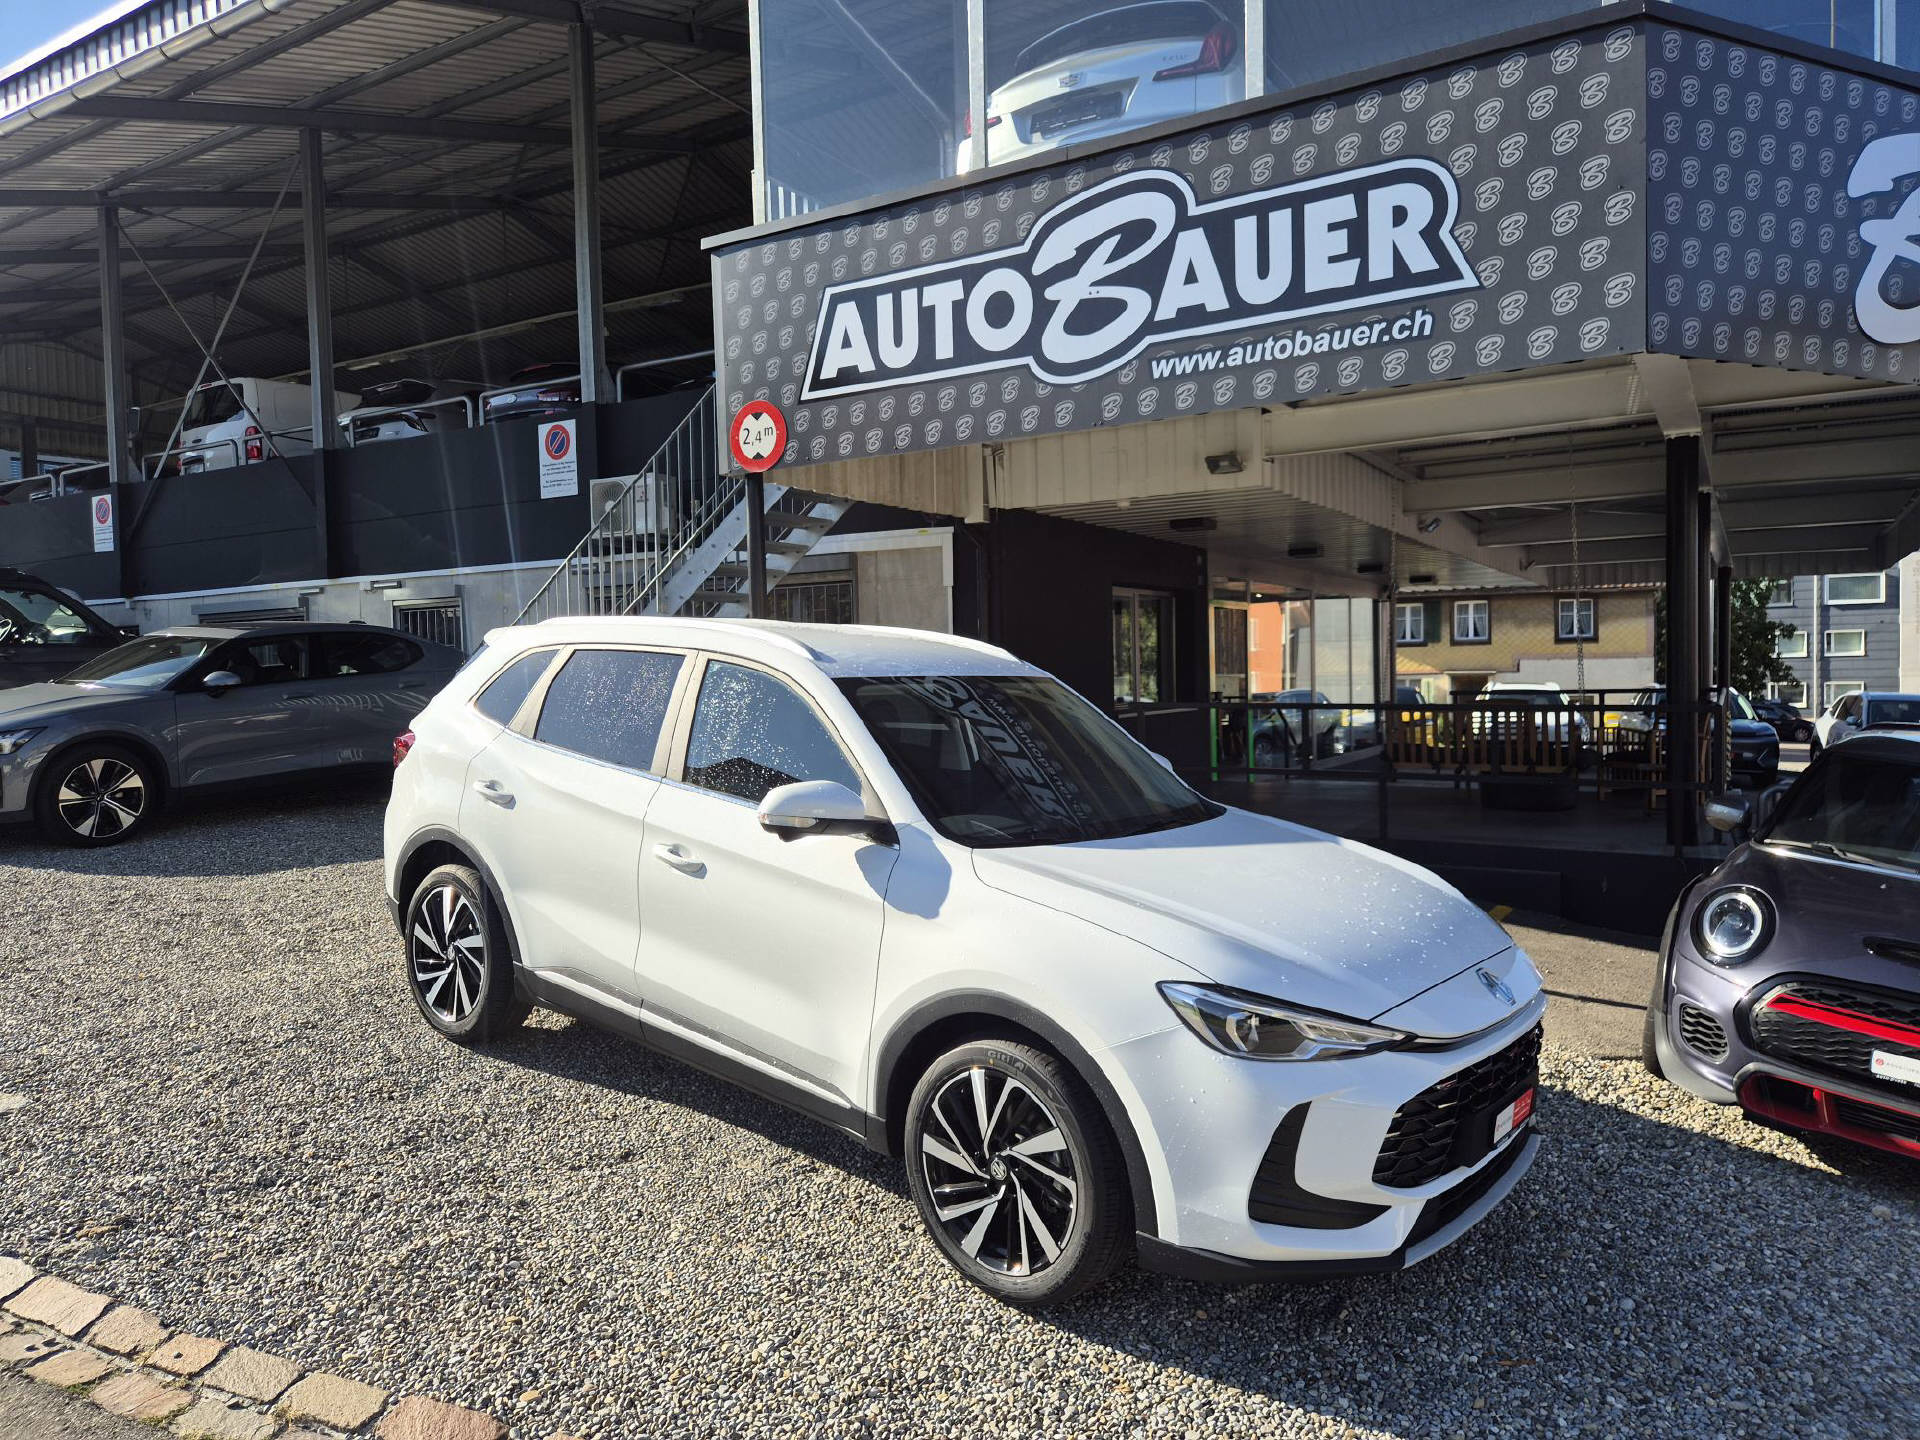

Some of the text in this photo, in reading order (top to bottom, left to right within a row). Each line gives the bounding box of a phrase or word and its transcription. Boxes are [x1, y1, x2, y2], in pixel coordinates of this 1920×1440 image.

[818, 180, 1440, 380] AUTO BAUER
[1151, 308, 1433, 379] www.autobauer.ch
